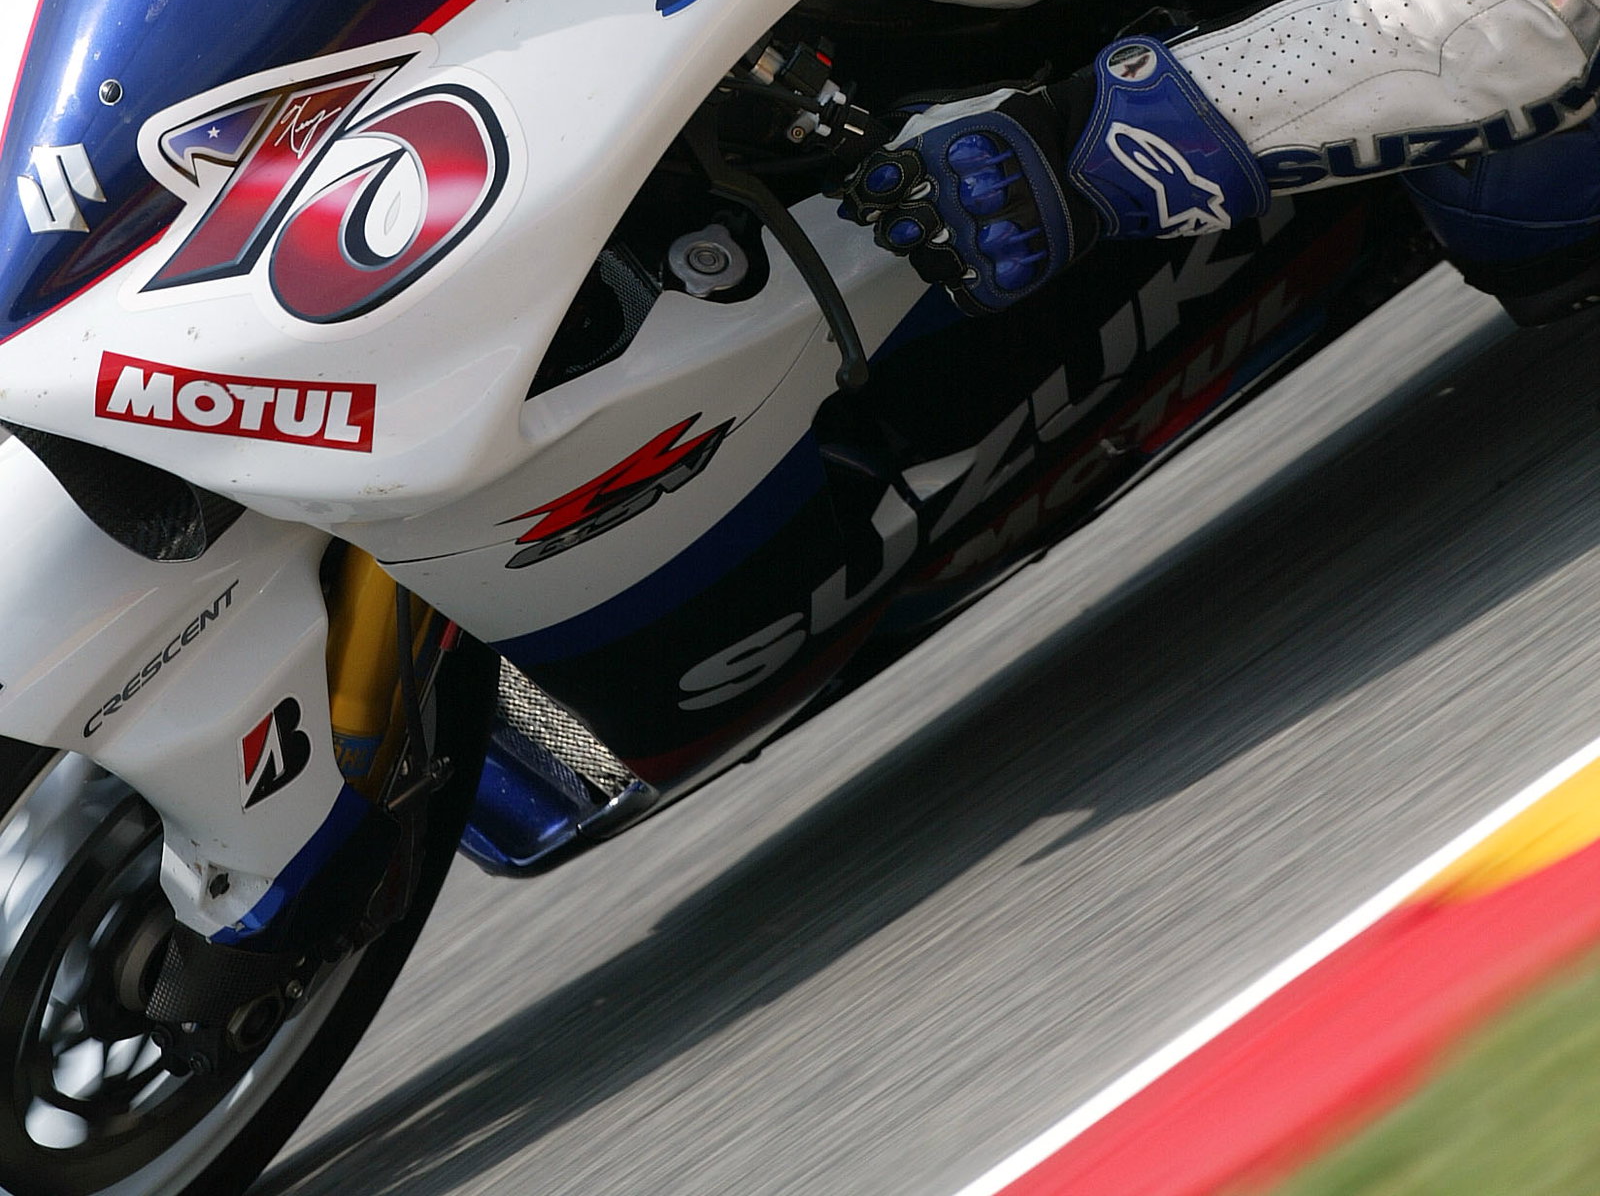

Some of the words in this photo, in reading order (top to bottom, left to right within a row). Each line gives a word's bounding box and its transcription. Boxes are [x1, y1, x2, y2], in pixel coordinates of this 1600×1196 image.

[138, 50, 511, 325] 10
[106, 365, 362, 444] MOTUL
[677, 196, 1295, 711] SUZUKI
[83, 579, 239, 738] CRESCENT
